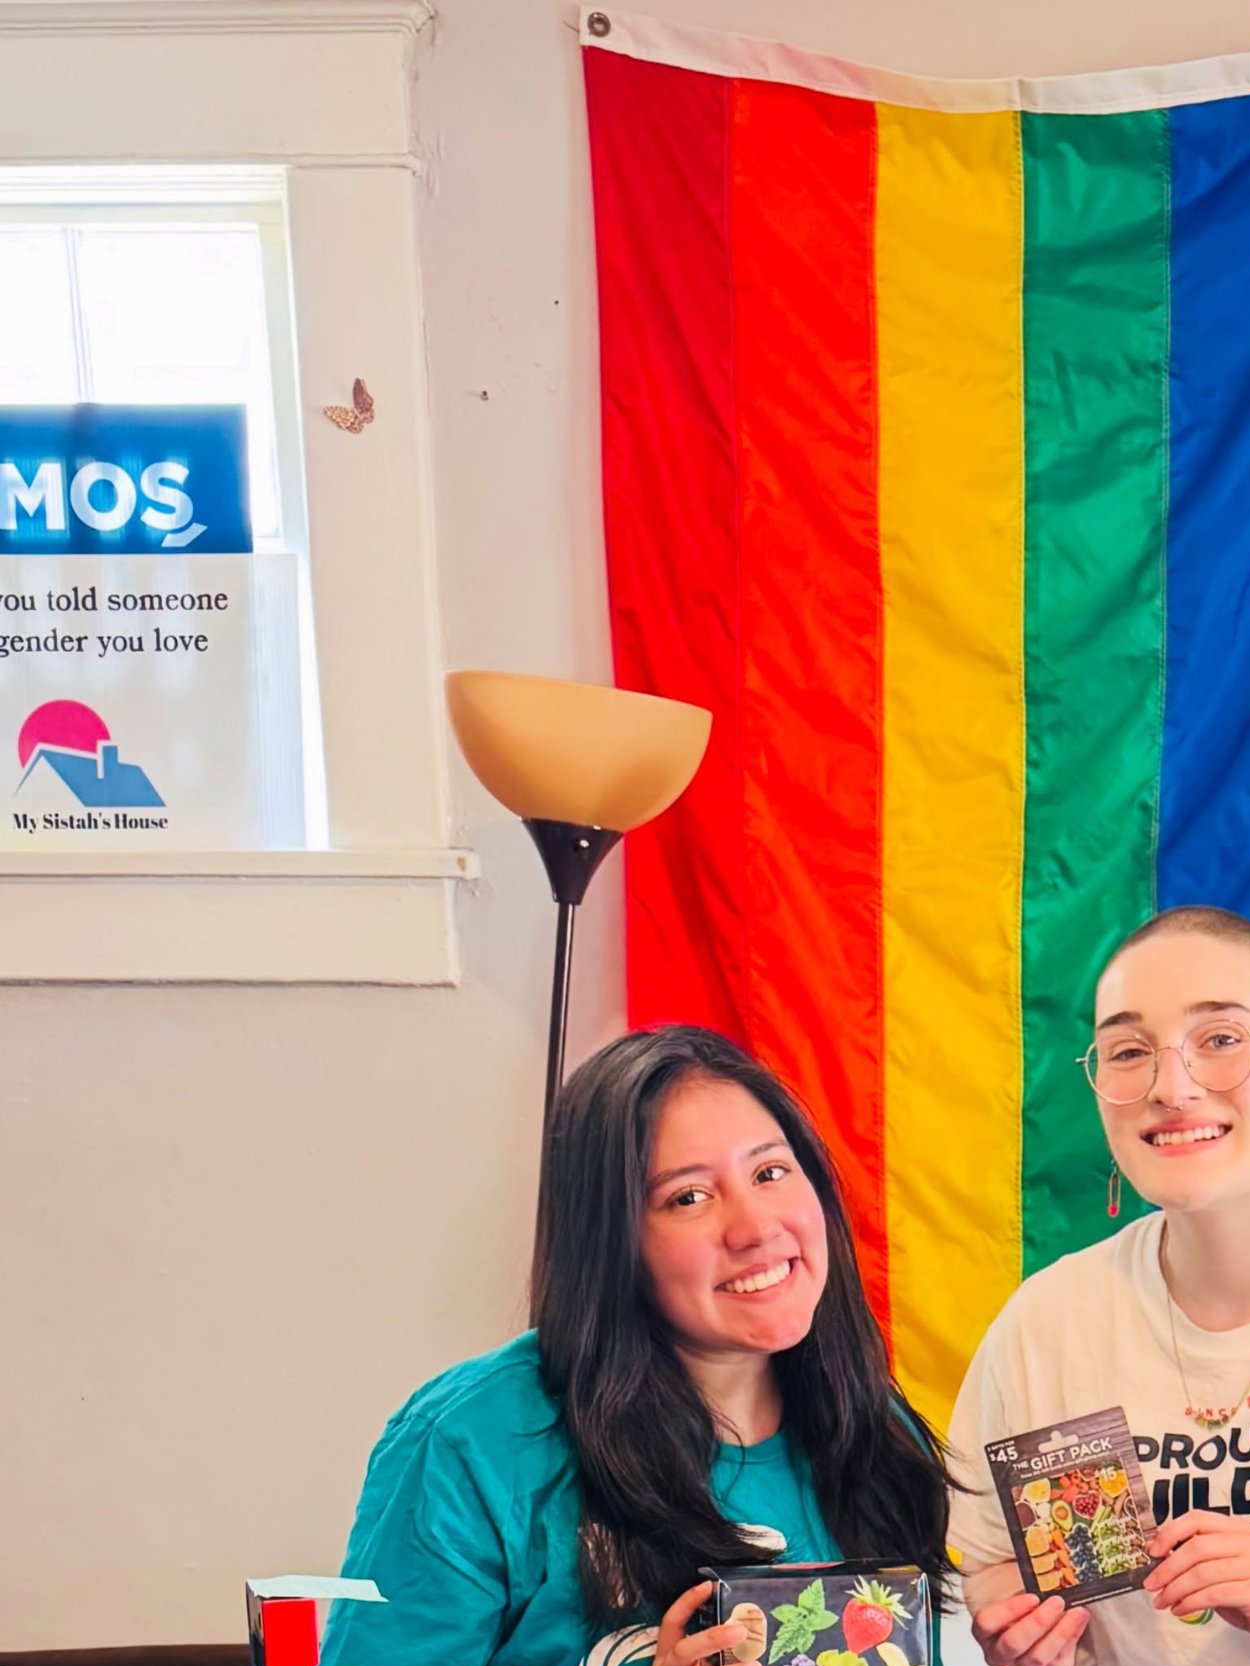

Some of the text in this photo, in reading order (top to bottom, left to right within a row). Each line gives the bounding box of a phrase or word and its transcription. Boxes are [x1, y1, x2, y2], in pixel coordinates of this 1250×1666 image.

[47, 586, 98, 611] told
[107, 592, 229, 611] someone
[97, 634, 145, 658] you
[153, 627, 209, 652] love
[13, 812, 169, 834] My Sistah's House
[1030, 1450, 1066, 1470] GIFT
[1069, 1437, 1112, 1459] PACK
